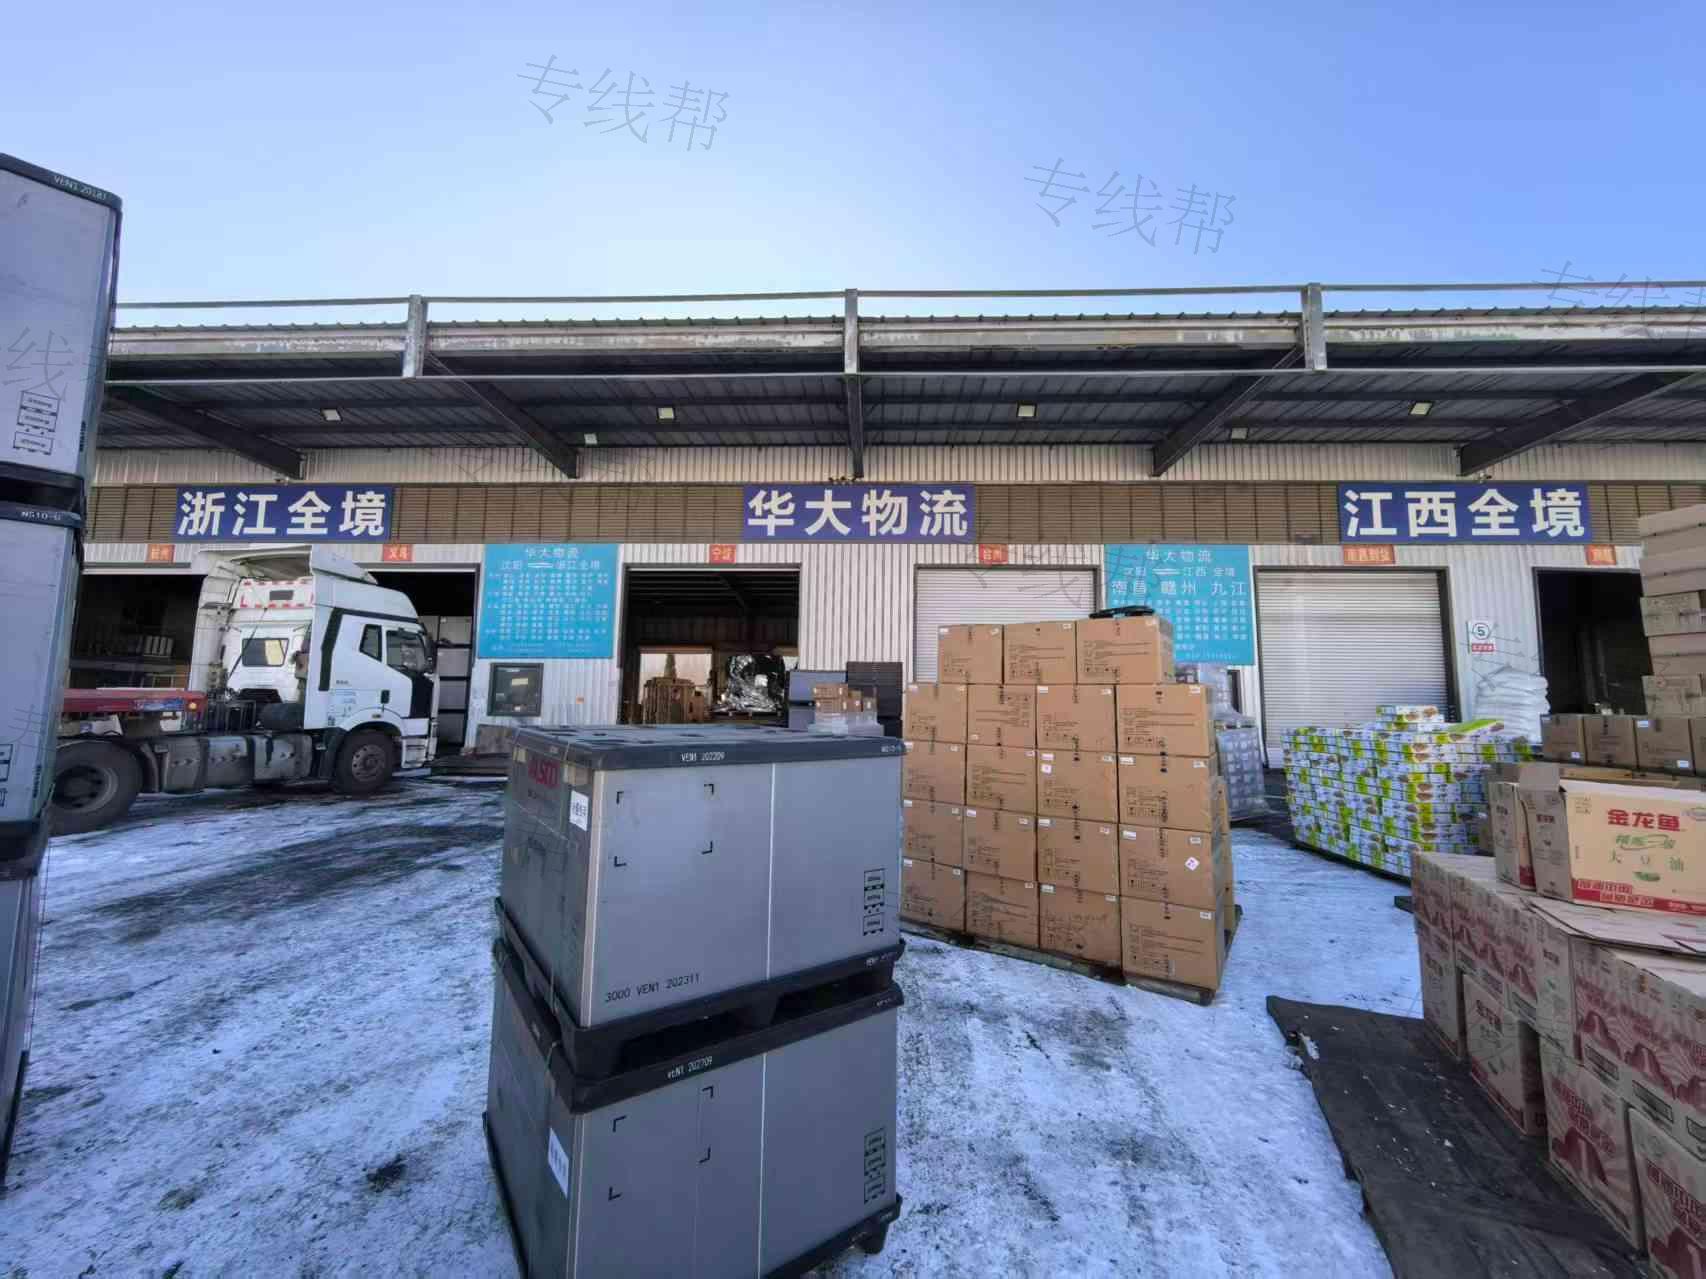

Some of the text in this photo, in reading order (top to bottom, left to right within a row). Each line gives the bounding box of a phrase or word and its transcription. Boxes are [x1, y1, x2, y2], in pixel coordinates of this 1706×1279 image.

[177, 490, 386, 536] 浙江全境
[748, 489, 968, 536] 华大物流
[1344, 488, 1585, 537] 江西全境
[1607, 808, 1682, 832] 金龙鱼
